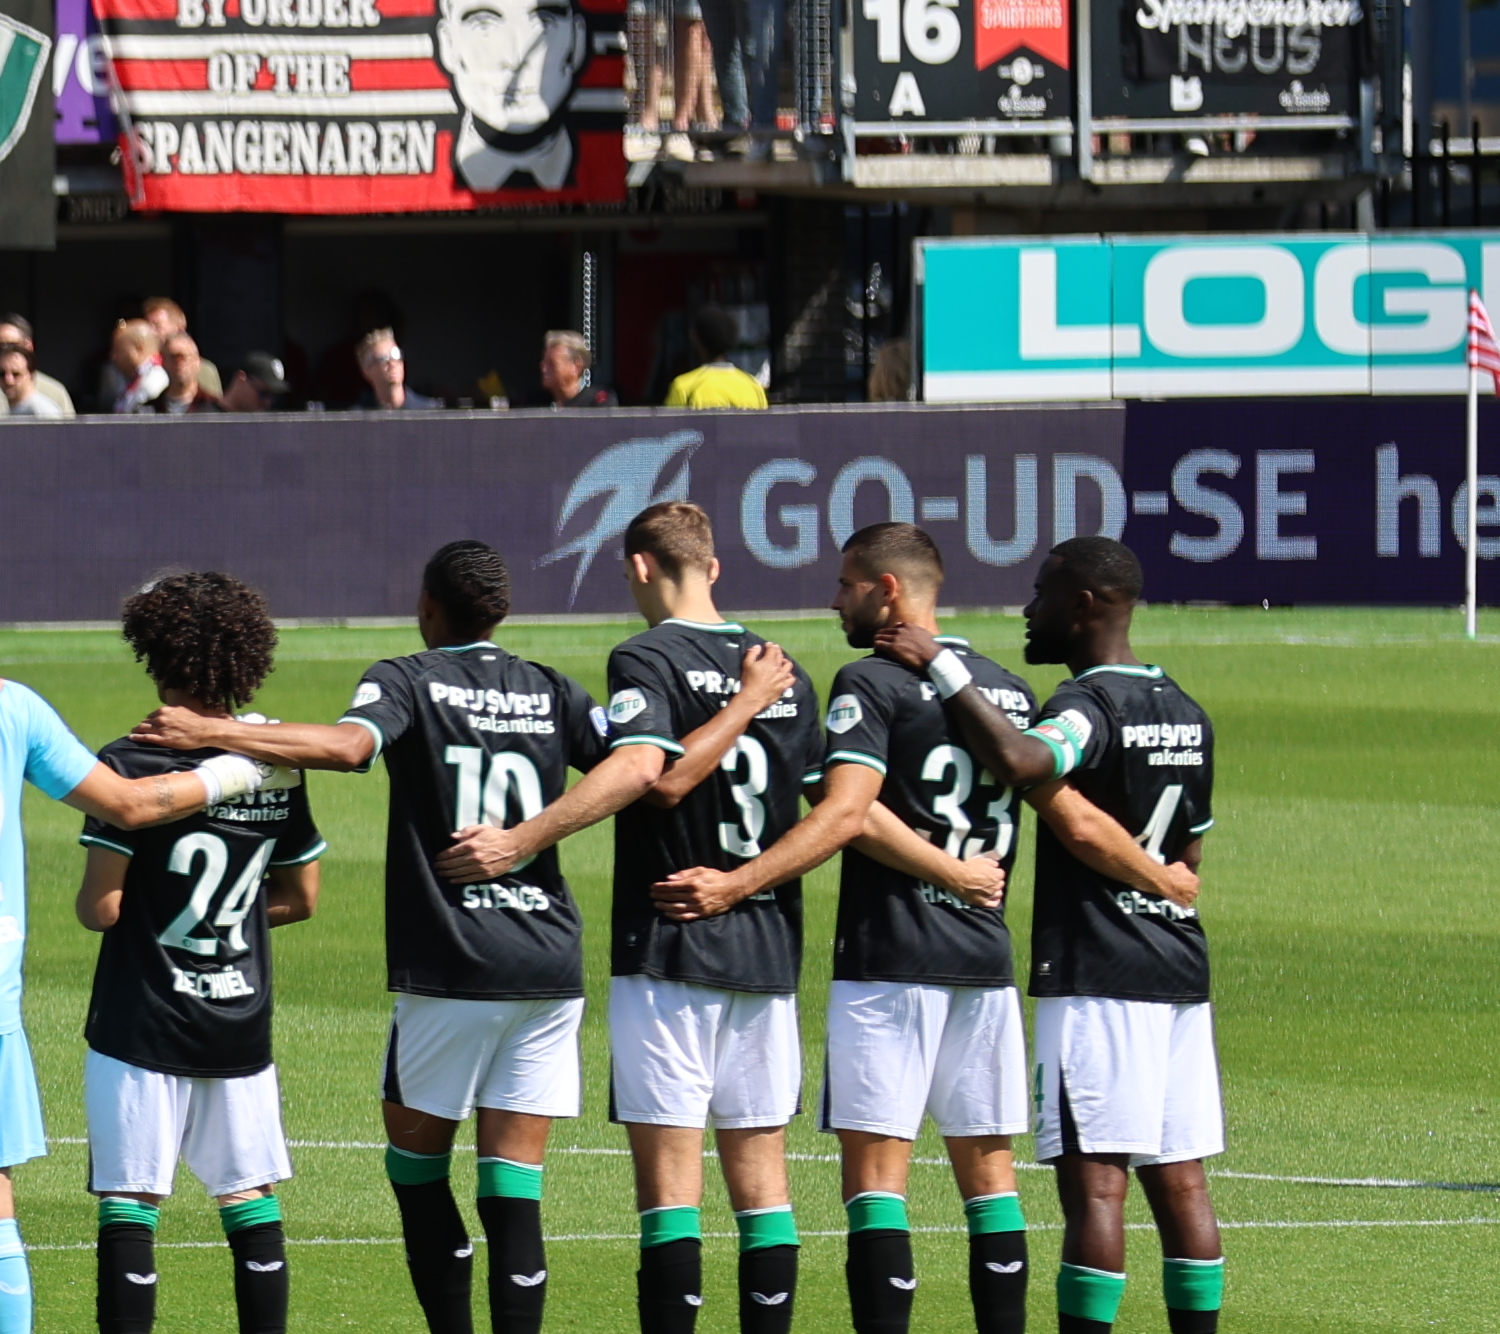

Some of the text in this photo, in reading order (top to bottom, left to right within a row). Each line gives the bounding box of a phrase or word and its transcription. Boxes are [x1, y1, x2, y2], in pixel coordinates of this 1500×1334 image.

[207, 51, 351, 96] OF THE
[889, 75, 925, 116] A
[136, 120, 437, 176] SPANGENAREN
[740, 447, 1317, 568] GO-UD-SE
[444, 745, 543, 874] 10
[718, 734, 768, 858] 3
[157, 831, 276, 956] 24
